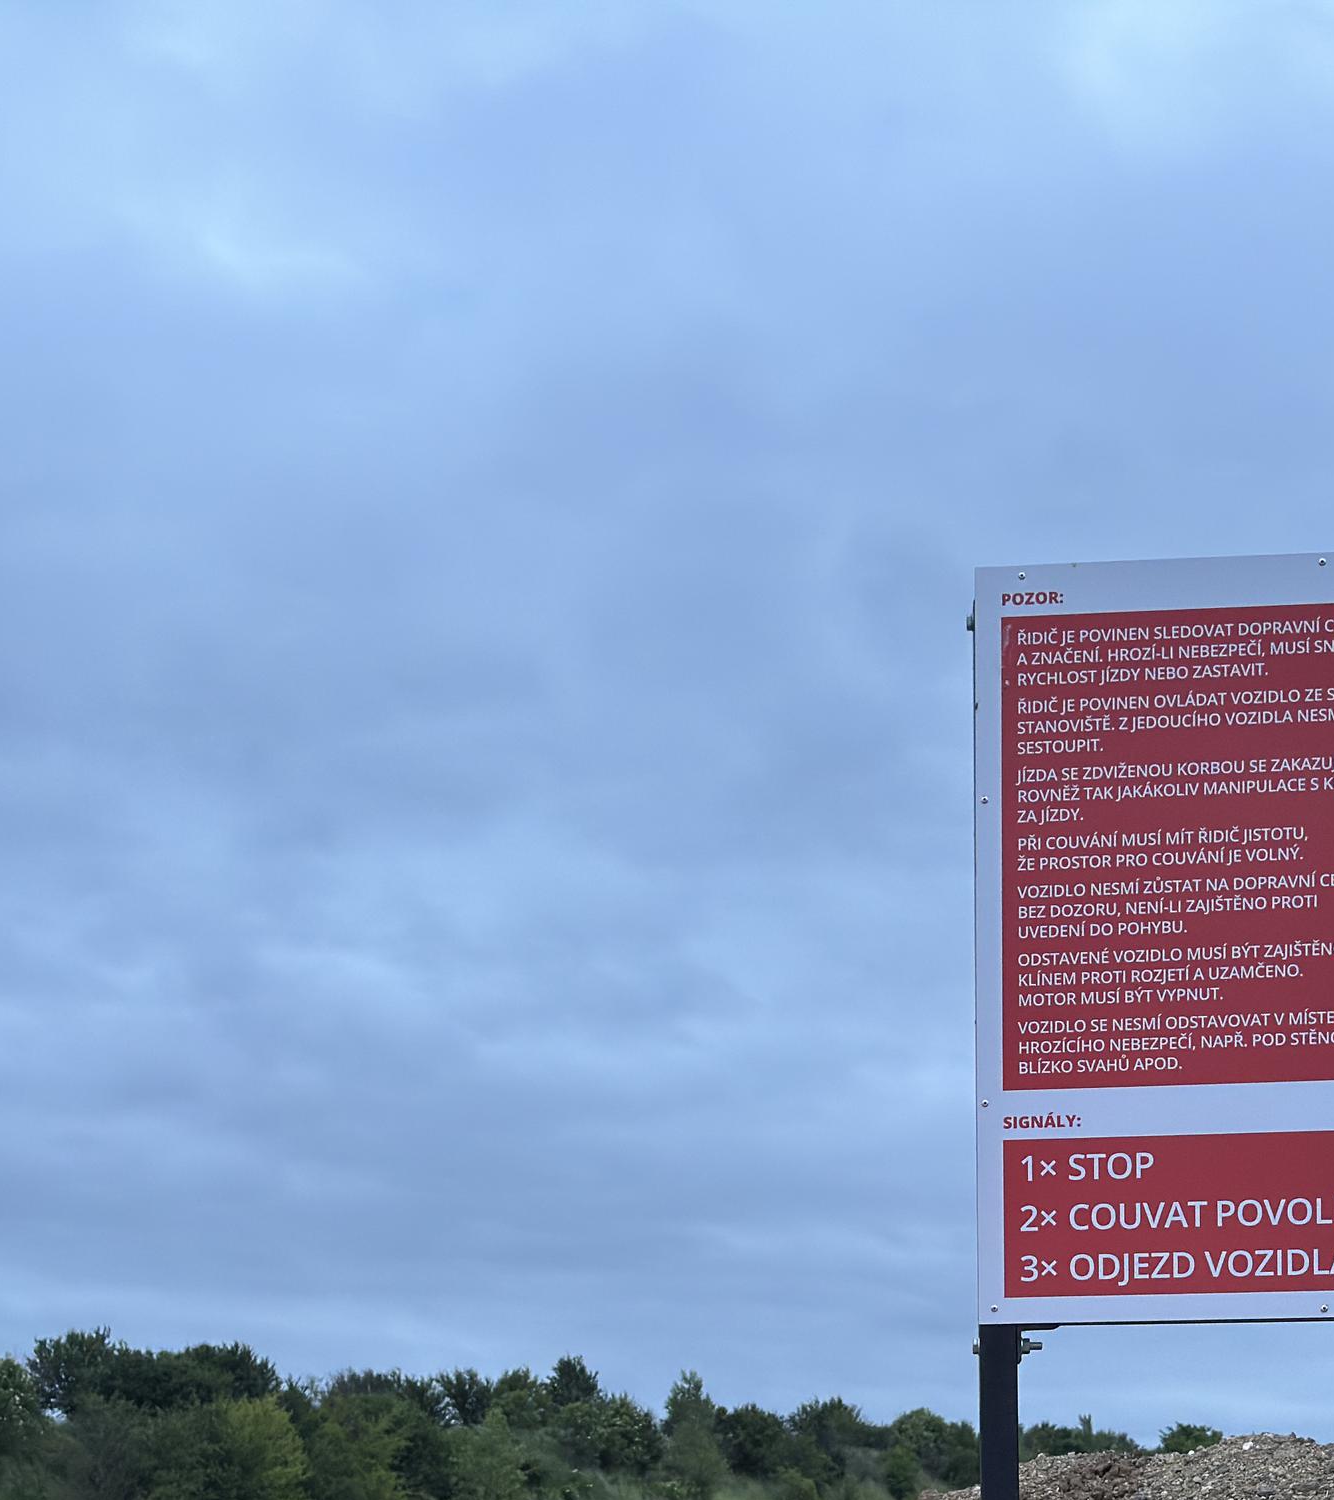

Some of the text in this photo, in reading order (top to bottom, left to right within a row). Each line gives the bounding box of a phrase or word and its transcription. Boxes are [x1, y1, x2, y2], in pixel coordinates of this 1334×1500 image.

[1001, 591, 1064, 606] POZOR:
[1017, 627, 1058, 646] ŘIDIČ
[1059, 630, 1075, 647] JE
[1079, 626, 1149, 643] POVINEN
[1153, 623, 1234, 640] SLEDOVAT
[1238, 616, 1321, 636] DOPRAVNÍ
[1016, 652, 1028, 666] A
[1031, 645, 1103, 665] ZNAČENÍ.
[1108, 643, 1174, 662] HROZÍ-LI
[1178, 638, 1265, 659] NEBEZPEČÍ,
[1270, 636, 1310, 655] MUSÍ
[1017, 662, 1268, 687] RYCHLOST JÍZDY NEBO ZASTAVIT.
[1015, 766, 1058, 786] JÍZDA
[1061, 767, 1079, 781] SE
[1082, 762, 1173, 780] ZDVIŽENOU
[1177, 760, 1245, 776] KORBOU
[1249, 759, 1267, 773] SE
[1018, 784, 1080, 803] ROVNĚŽ
[1083, 785, 1114, 800] TAK
[1115, 781, 1199, 802] JAKÁKOLIV
[1203, 777, 1306, 796] MANIPULACE
[1310, 777, 1319, 791] S
[1017, 805, 1084, 826] ZA JÍZDY.
[1018, 825, 1308, 851] PŘI COUVÁNÍ MUSÍ MÍT ŘIDIČ JISTOTU,
[1017, 843, 1304, 872] ŽE PROSTOR PRO COUVÁNÍ JE VOLNÝ.
[1017, 883, 1086, 899] VOZIDLO
[1090, 877, 1140, 897] NESMÍ
[1143, 876, 1202, 894] ZŮSTAT
[1206, 877, 1230, 892] NA
[1233, 870, 1316, 891] DOPRAVNÍ
[1018, 894, 1318, 919] BEZ DOZORU, NENÍ-LI ZAJIŠTĚNO PROTI
[1018, 920, 1188, 939] UVEDENÍ DO POHYBU.
[1018, 947, 1110, 967] ODSTAVENÉ
[1112, 948, 1183, 963] VOZIDLO
[1187, 942, 1227, 961] MUSÍ
[1231, 942, 1261, 959] BÝT
[1018, 961, 1303, 987] KLÍNEM PROTI ROZJETÍ A UZAMČENO.
[1017, 1019, 1086, 1034] VOZIDLO
[1090, 1018, 1108, 1032] SE
[1112, 1013, 1162, 1032] NESMÍ
[1165, 1013, 1271, 1030] ODSTAVOVAT
[1273, 1012, 1285, 1026] V
[1019, 1036, 1105, 1055] HROZÍCÍHO
[1109, 1032, 1196, 1052] NEBEZPEČÍ,
[1201, 1030, 1248, 1049] NAPŘ.
[1252, 1032, 1286, 1047] POD
[1019, 1054, 1183, 1075] BLÍZKO SVAHŮ APOD.
[1003, 1111, 1081, 1130] SIGNÁLY:
[1068, 1152, 1154, 1181] STOP
[1069, 1200, 1208, 1231] COUVAT
[1069, 1251, 1195, 1287] ODJEZD
